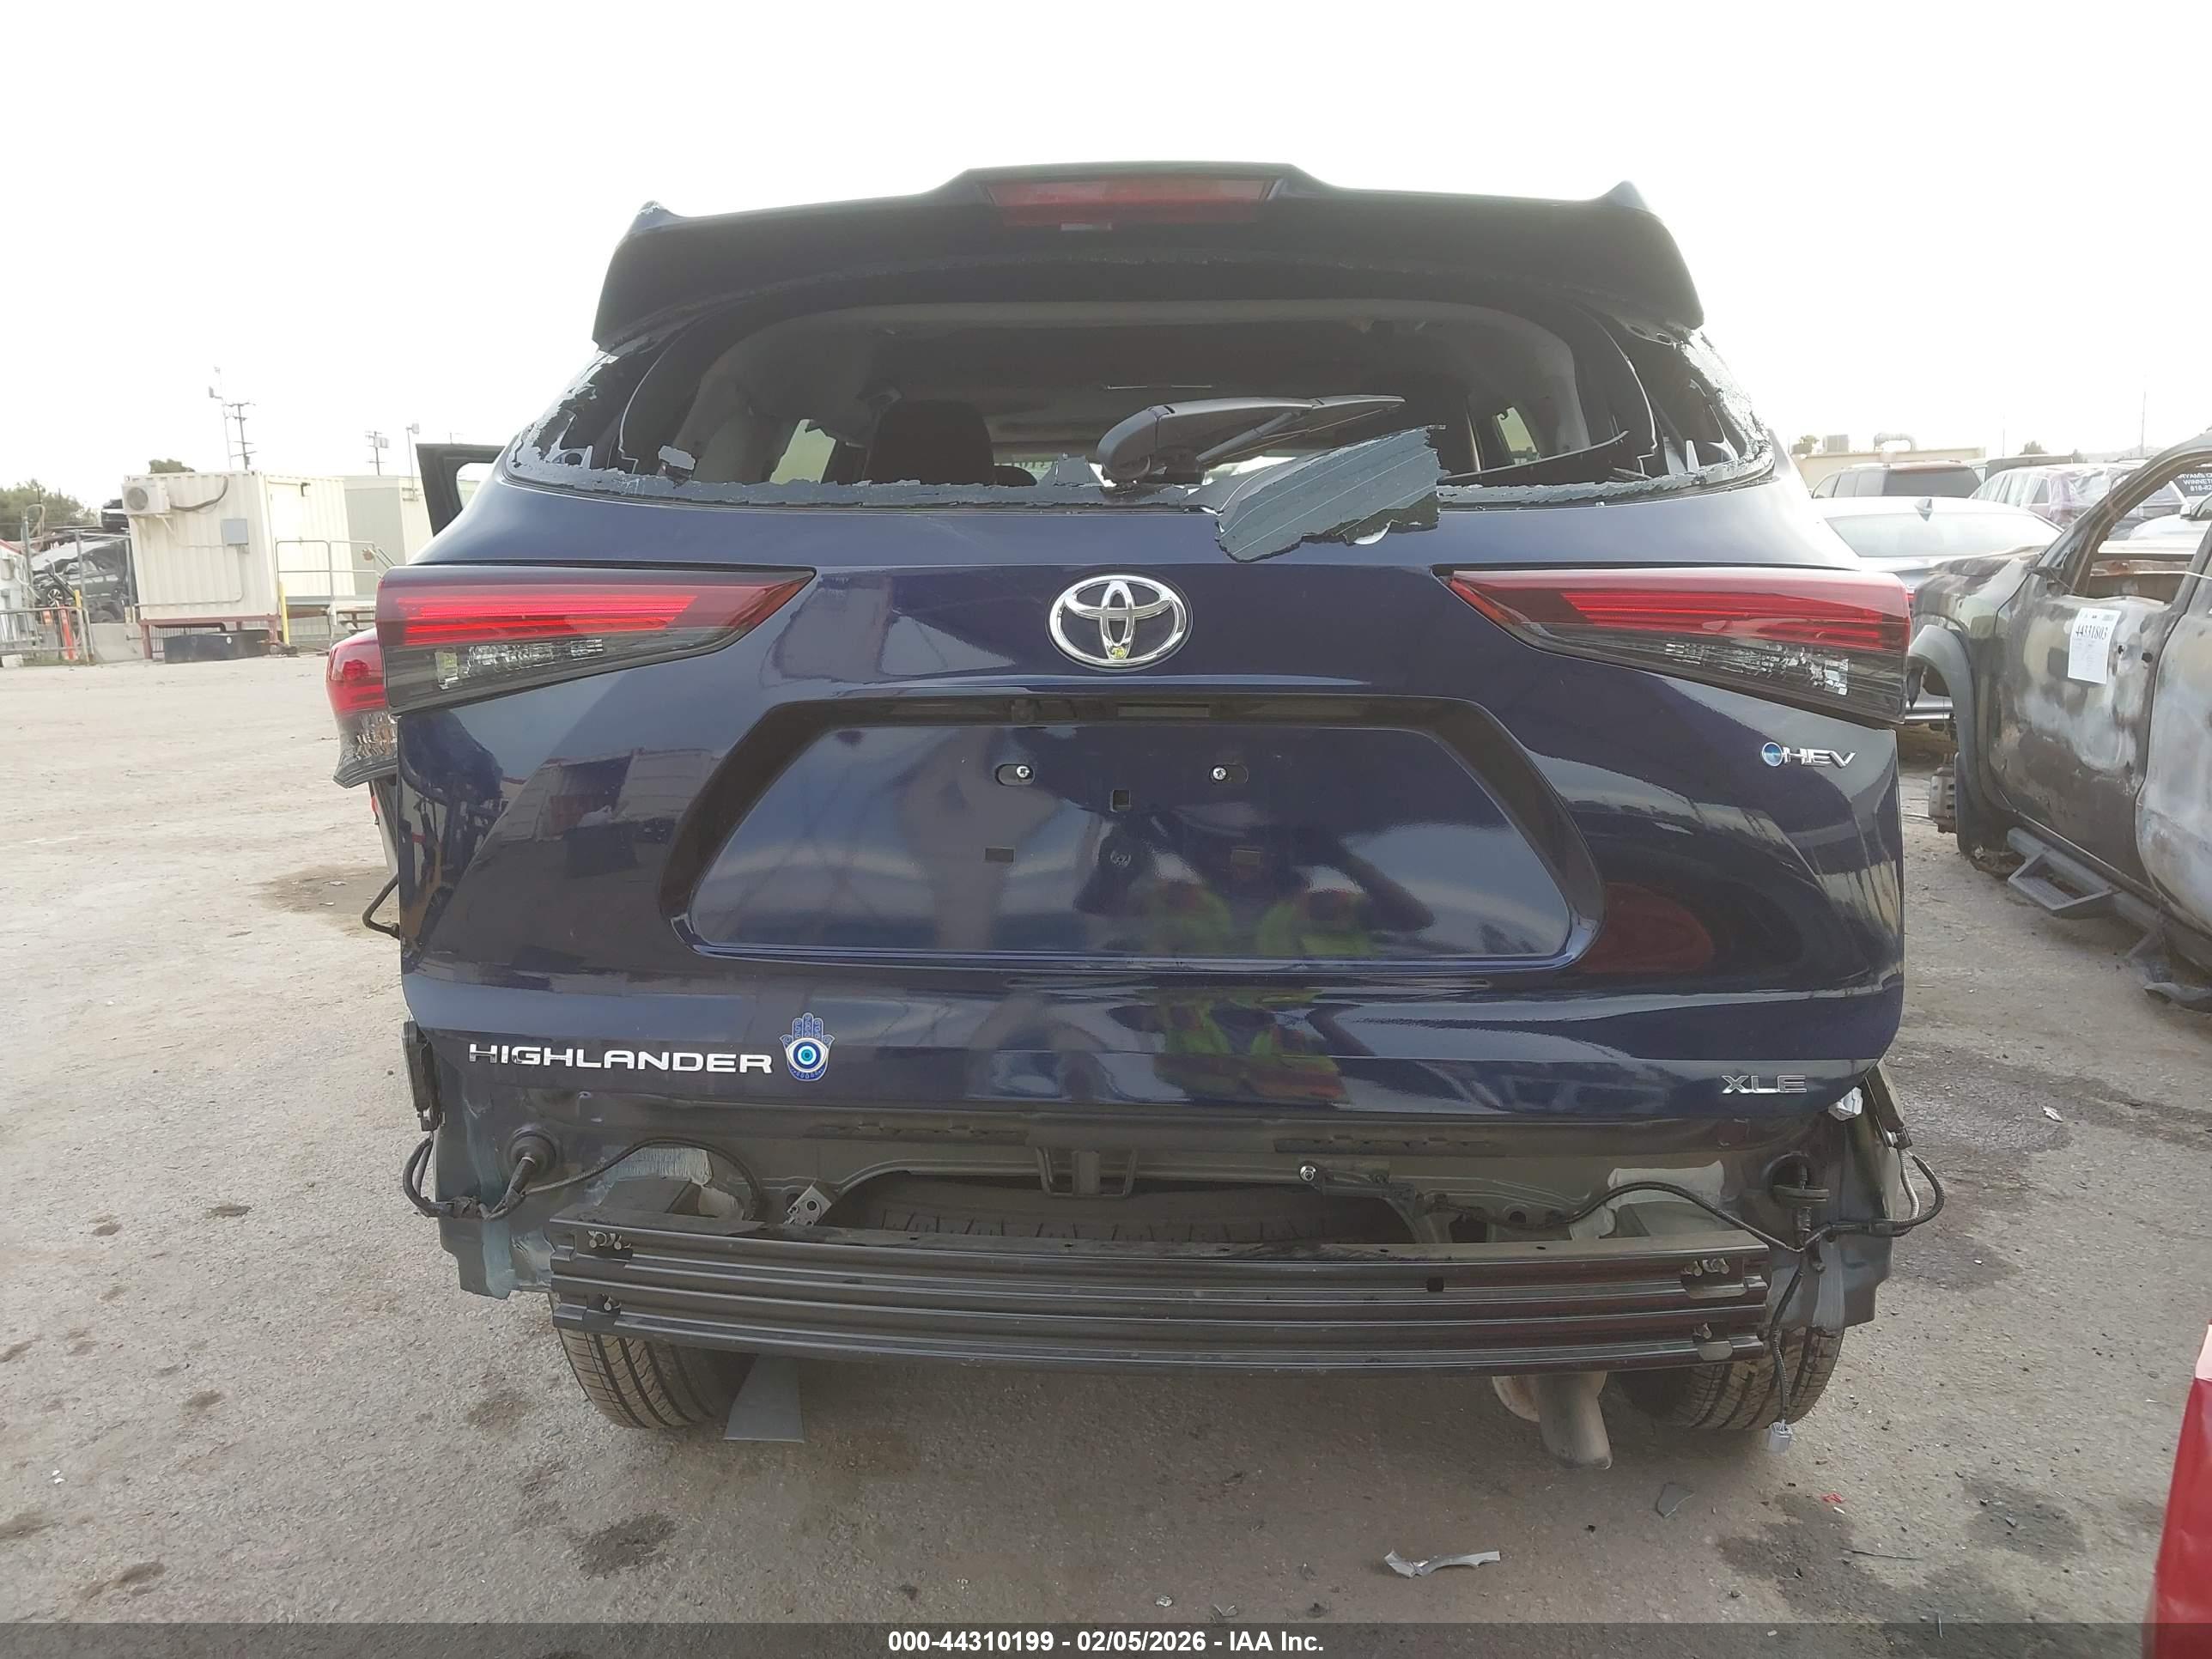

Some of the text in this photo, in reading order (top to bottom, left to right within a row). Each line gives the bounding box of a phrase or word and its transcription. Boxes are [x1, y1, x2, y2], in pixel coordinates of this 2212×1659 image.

[2075, 624, 2108, 640] 44331803
[1782, 745, 1856, 769] HEV
[469, 1042, 774, 1074] HIGHLANDER
[1721, 1074, 1808, 1094] XLE
